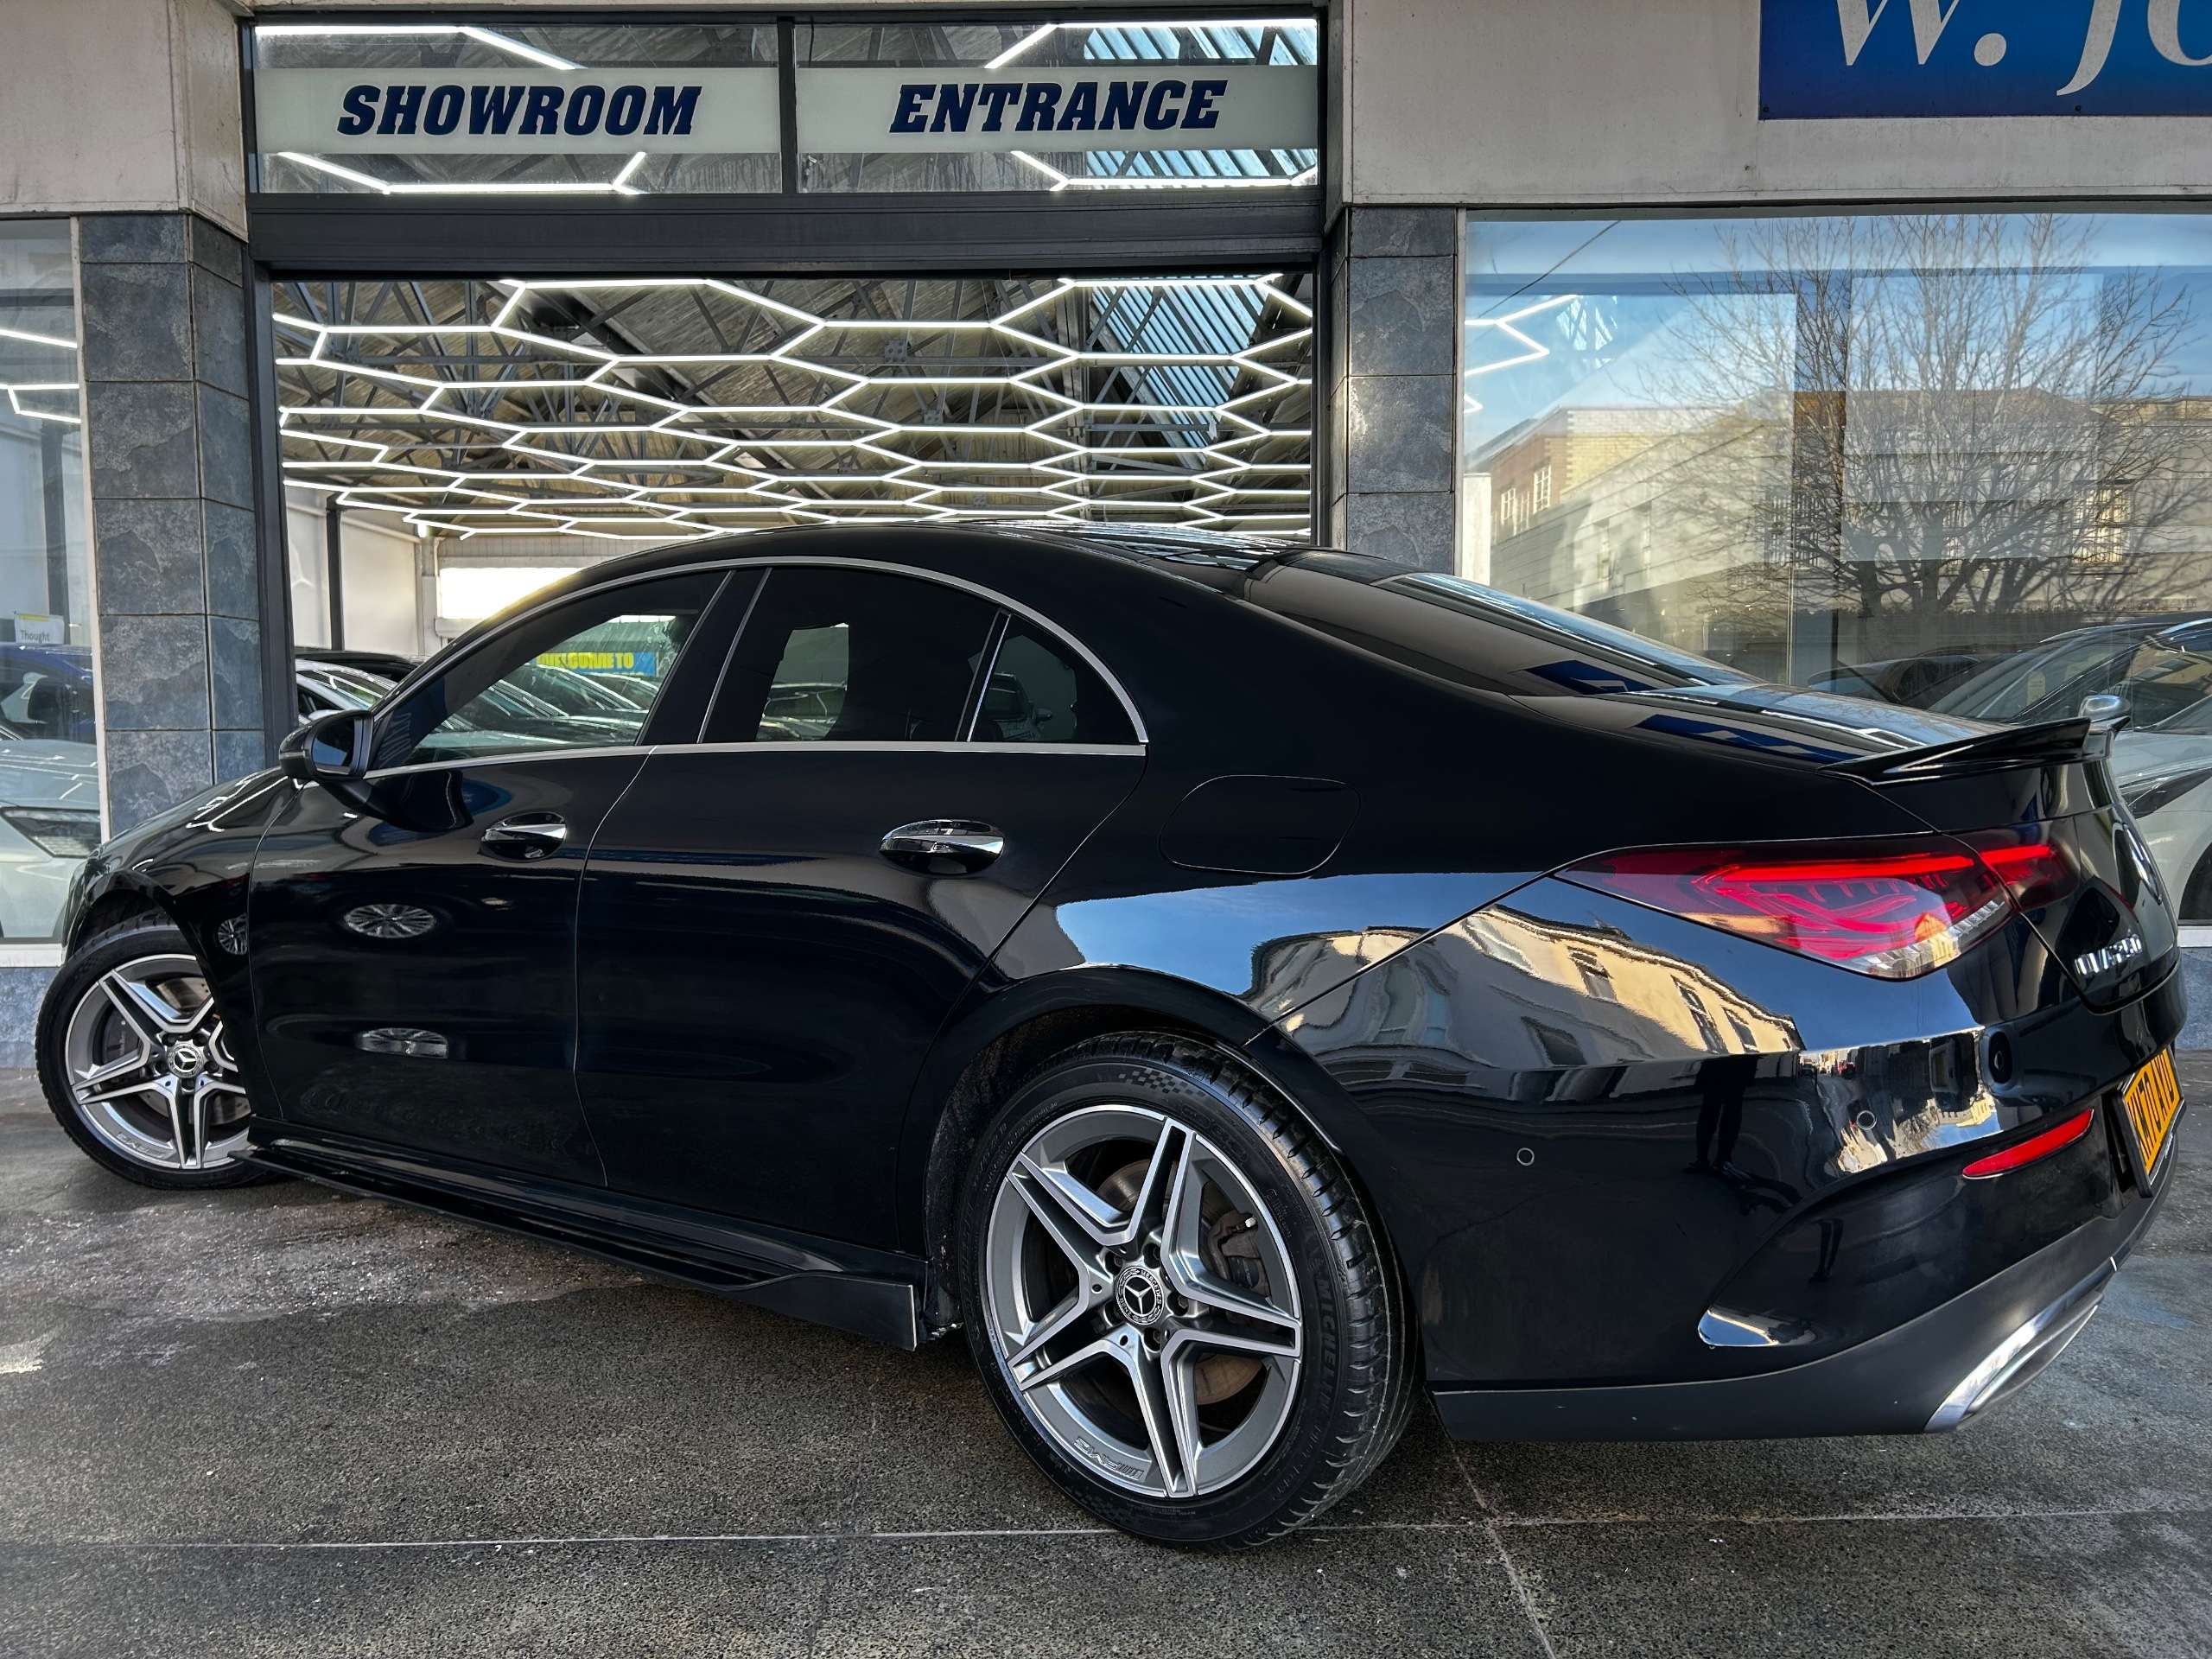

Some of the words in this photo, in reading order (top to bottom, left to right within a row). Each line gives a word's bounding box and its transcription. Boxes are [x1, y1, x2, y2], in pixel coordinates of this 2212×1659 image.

[2056, 0, 2212, 97] J
[337, 85, 702, 136] SHOWROOM
[889, 79, 1229, 133] ENTRANCE
[615, 652, 634, 669] TO
